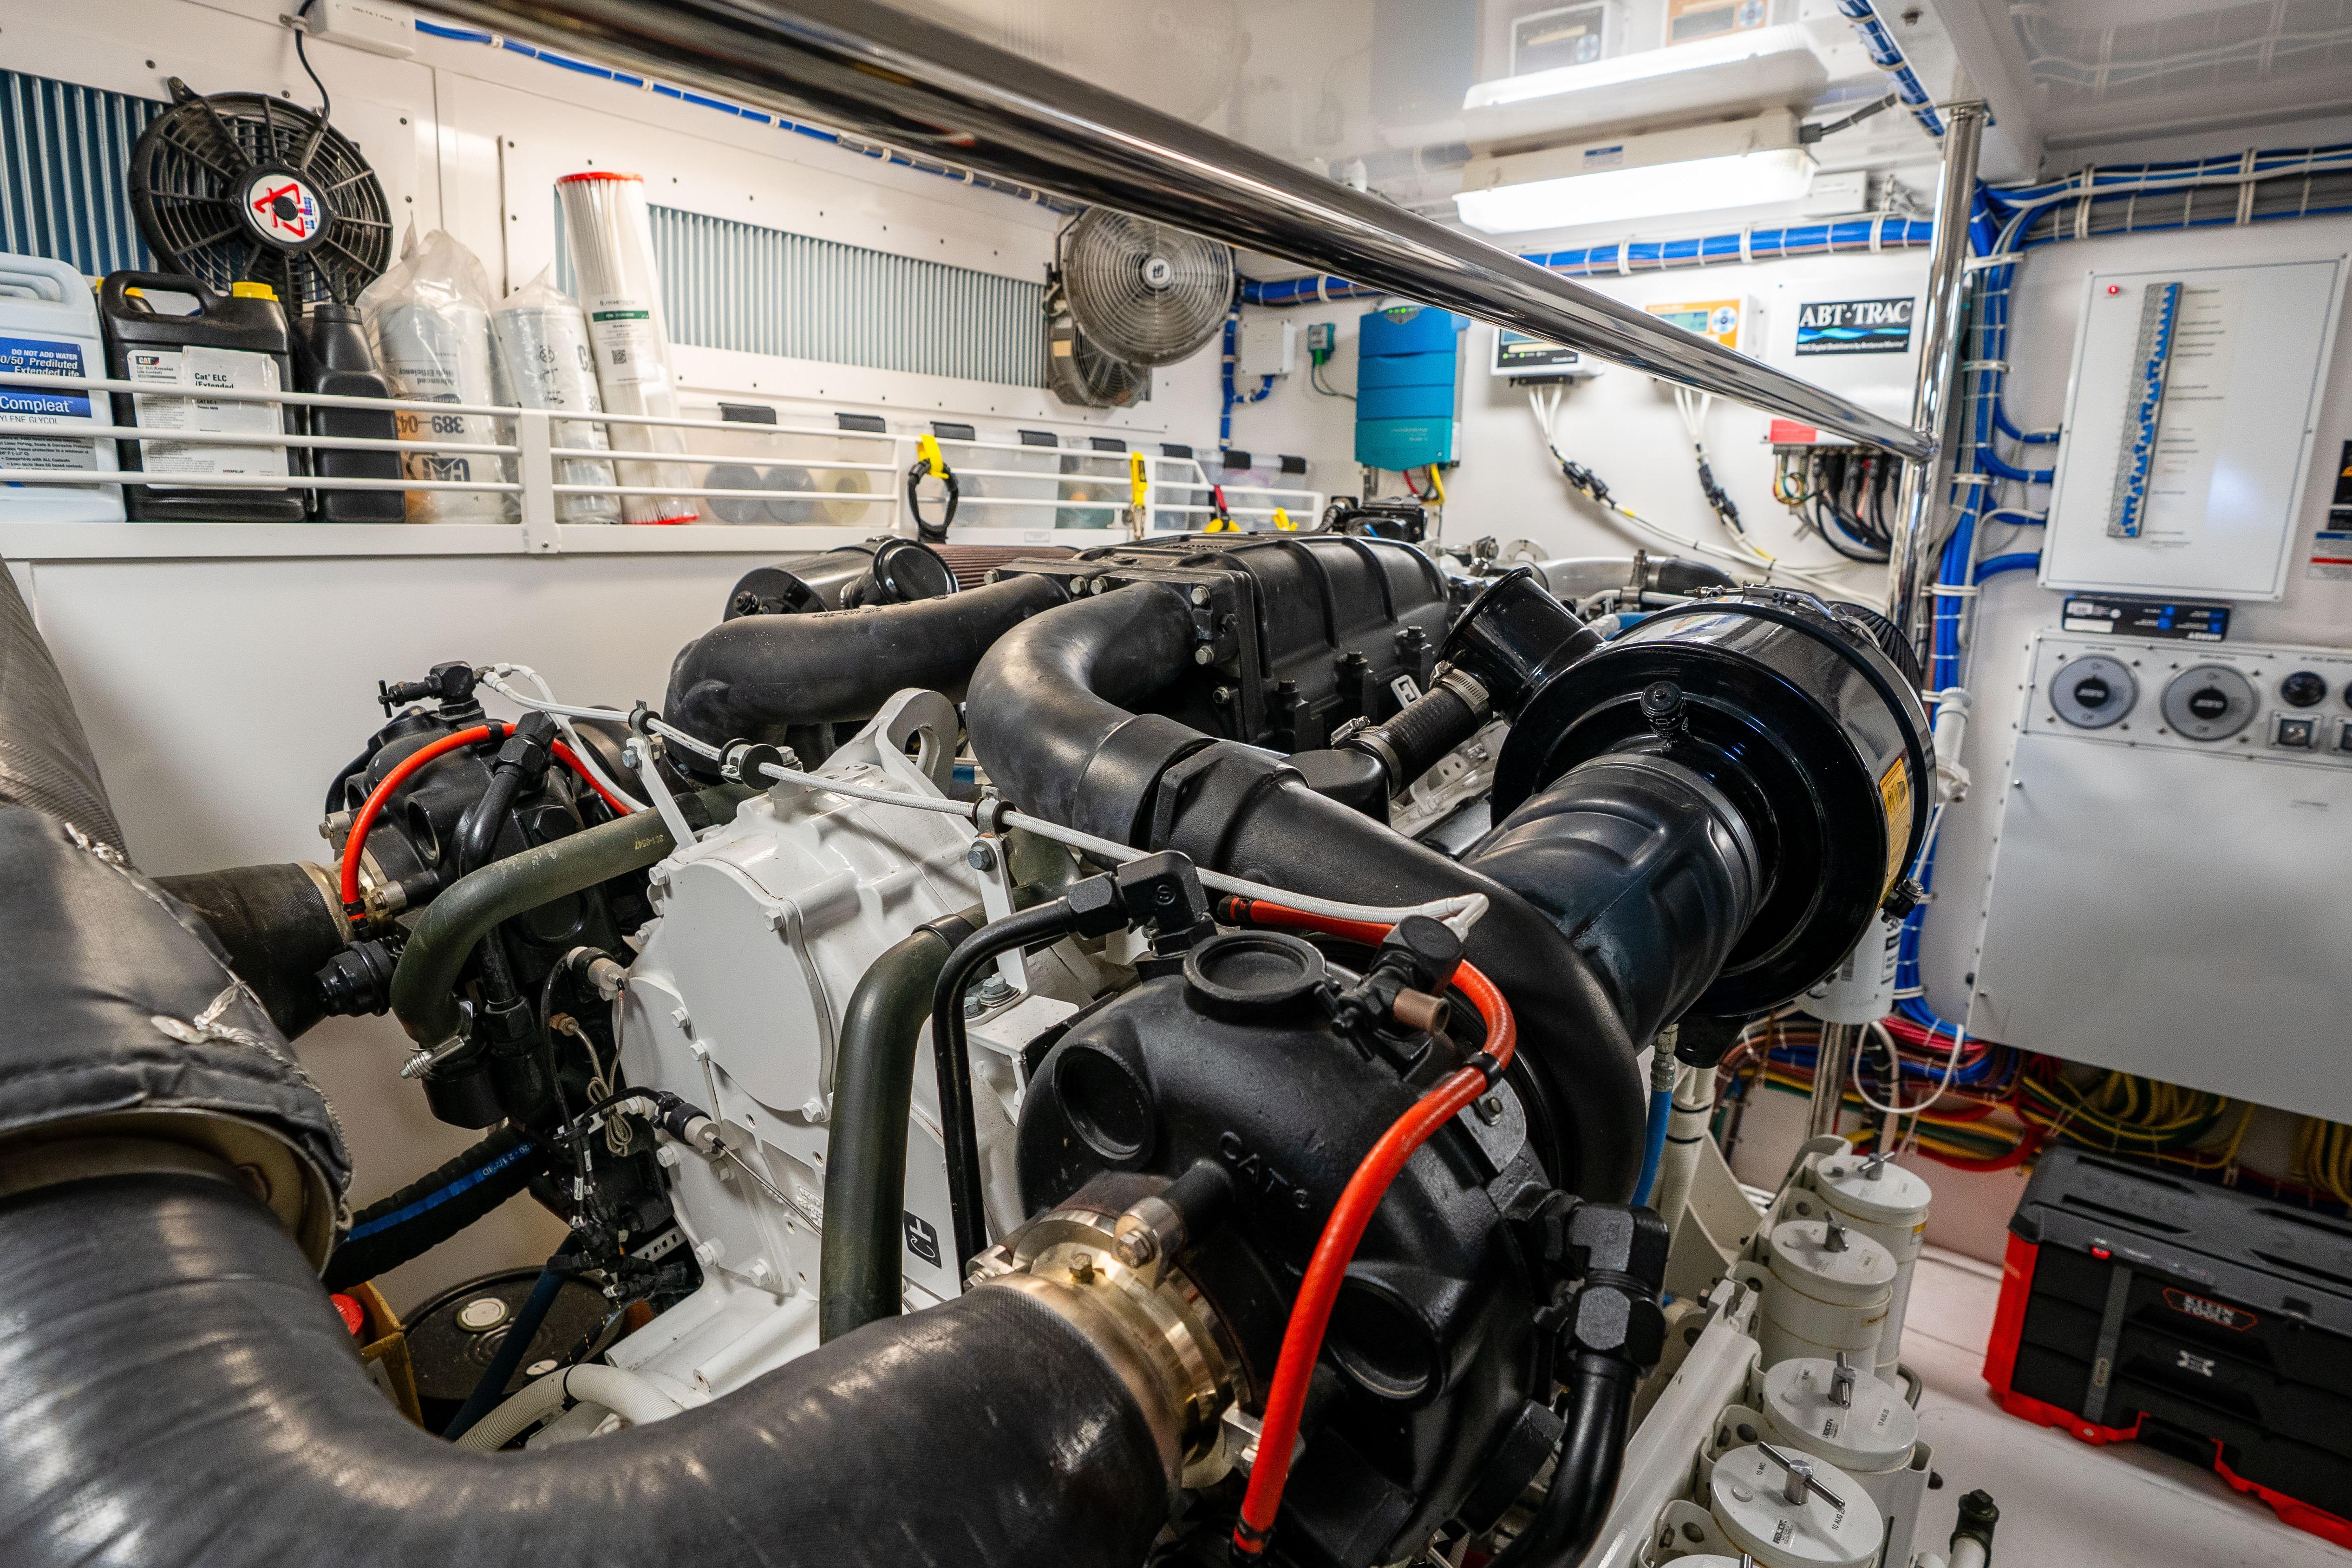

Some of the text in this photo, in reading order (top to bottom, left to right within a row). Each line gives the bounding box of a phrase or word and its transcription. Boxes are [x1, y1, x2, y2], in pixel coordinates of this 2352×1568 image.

[55, 352, 78, 360] WATER
[139, 356, 151, 365] CAT
[0, 355, 78, 370] 0/50 Prediluted
[212, 374, 227, 382] ELC
[1834, 1513, 1843, 1526] AUG
